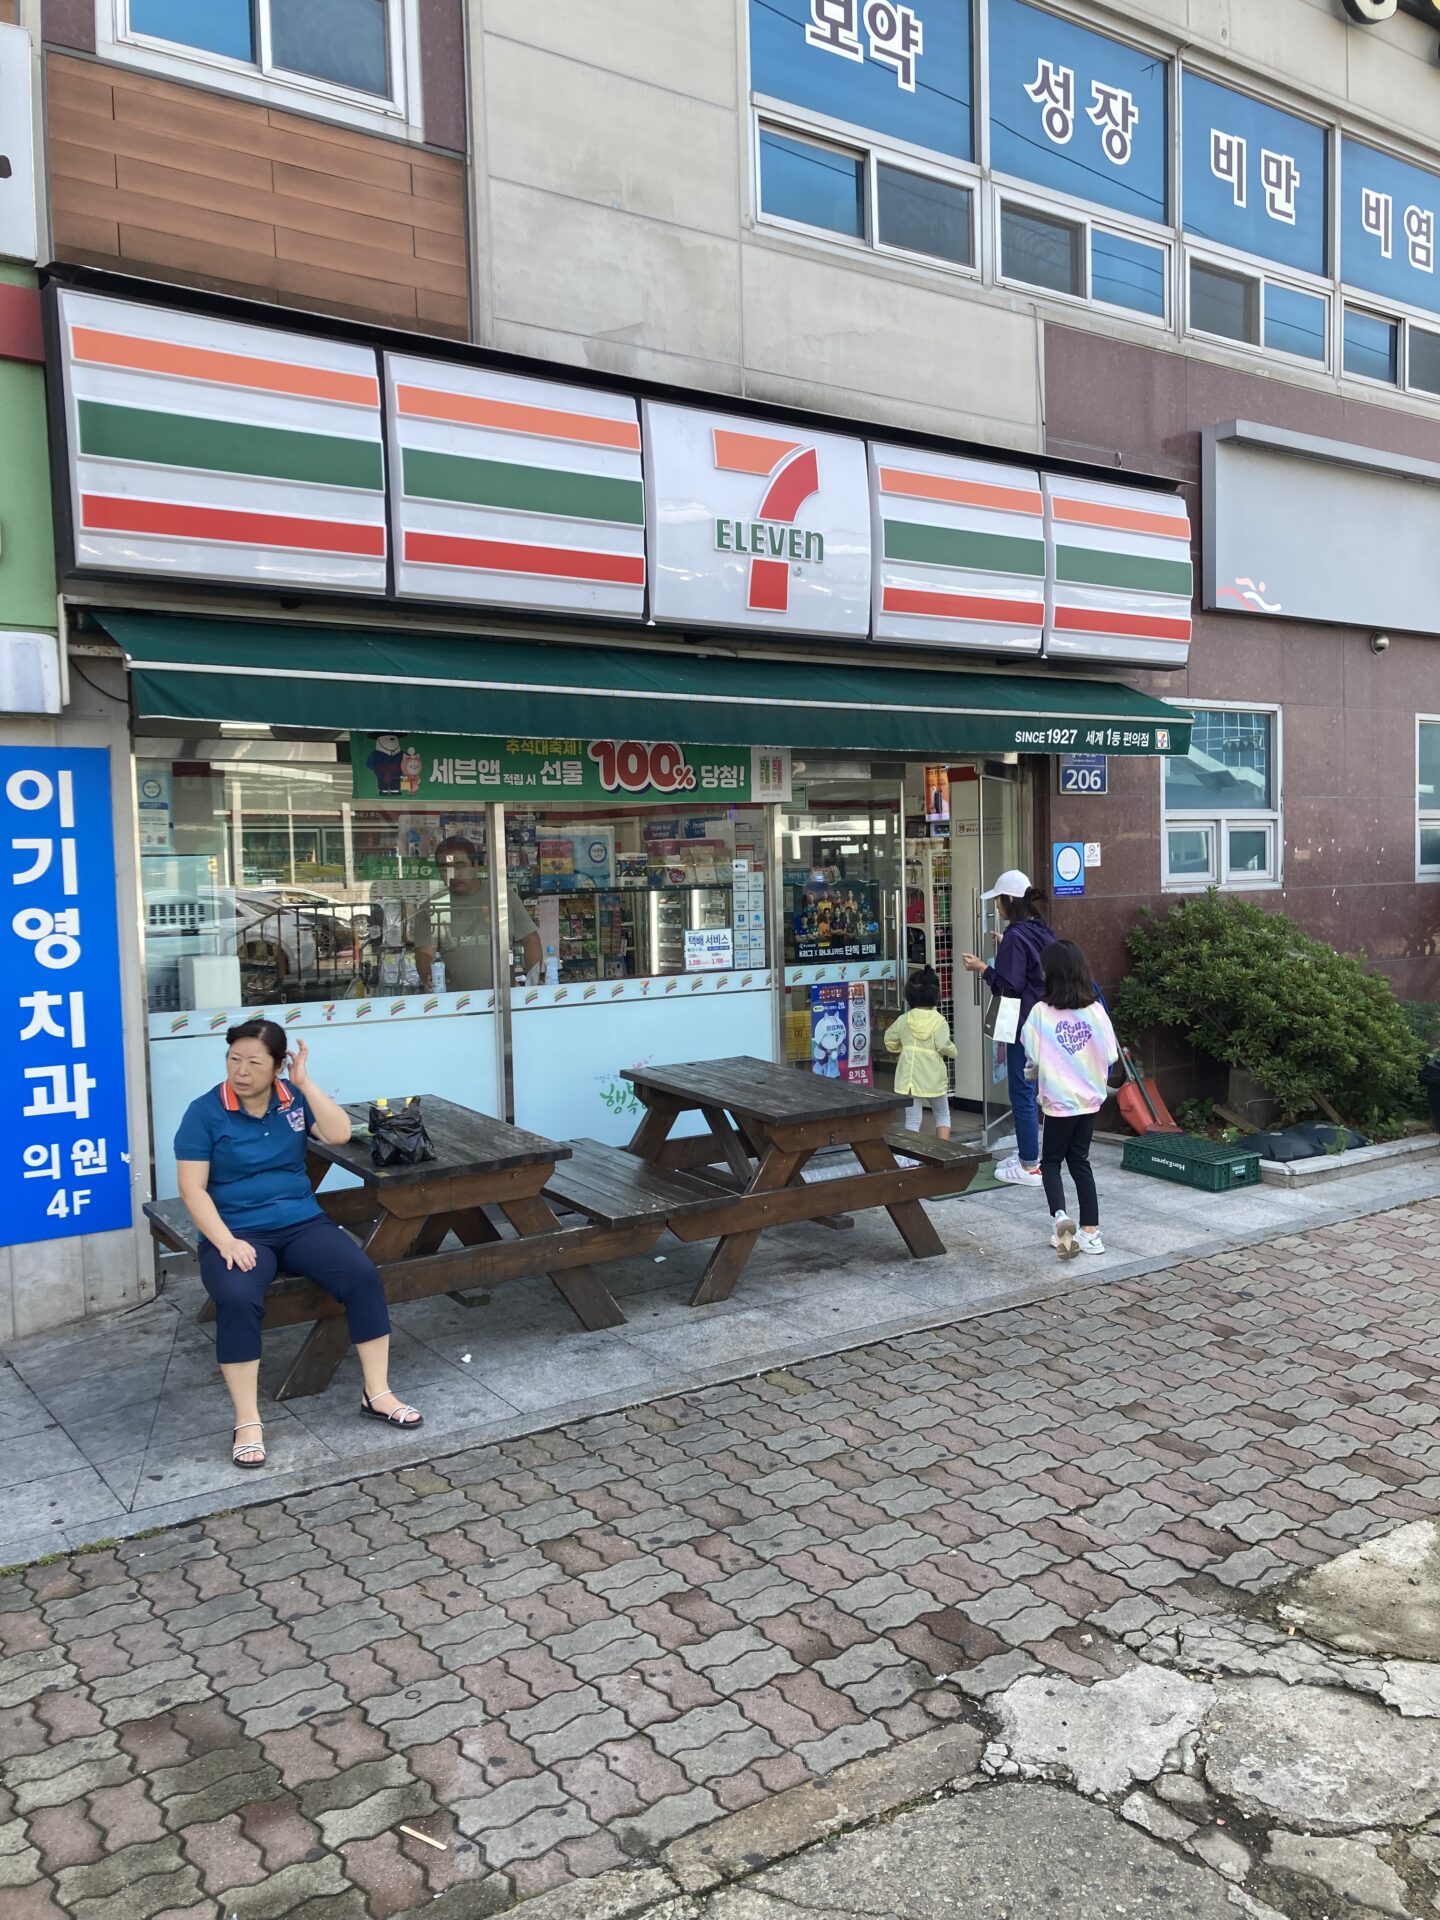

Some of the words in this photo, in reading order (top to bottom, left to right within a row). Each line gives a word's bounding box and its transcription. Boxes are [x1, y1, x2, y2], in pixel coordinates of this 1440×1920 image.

[805, 0, 923, 93] 보약
[1024, 57, 1139, 166] 성장
[1210, 128, 1300, 226] 비만
[1361, 186, 1434, 275] 비염
[1014, 730, 1046, 744] SINCE
[1047, 728, 1078, 745] 1927
[1085, 730, 1105, 746] 세계
[1106, 728, 1121, 746] 1등
[1122, 731, 1150, 748] 편의점
[429, 758, 501, 785] 세븐앱
[539, 760, 583, 786] 선물
[588, 740, 697, 794] 100%
[700, 764, 745, 789] 당첨!
[1066, 769, 1101, 790] 206
[5, 769, 97, 1121] 이기영치과
[688, 935, 704, 946] 택배
[705, 933, 729, 945] 서비스
[844, 945, 860, 956] 단독
[861, 943, 877, 954] 판매
[1054, 1020, 1093, 1034] Because
[848, 1069, 867, 1080] 요기요
[22, 1137, 109, 1182] 의원
[46, 1188, 92, 1219] 4F
